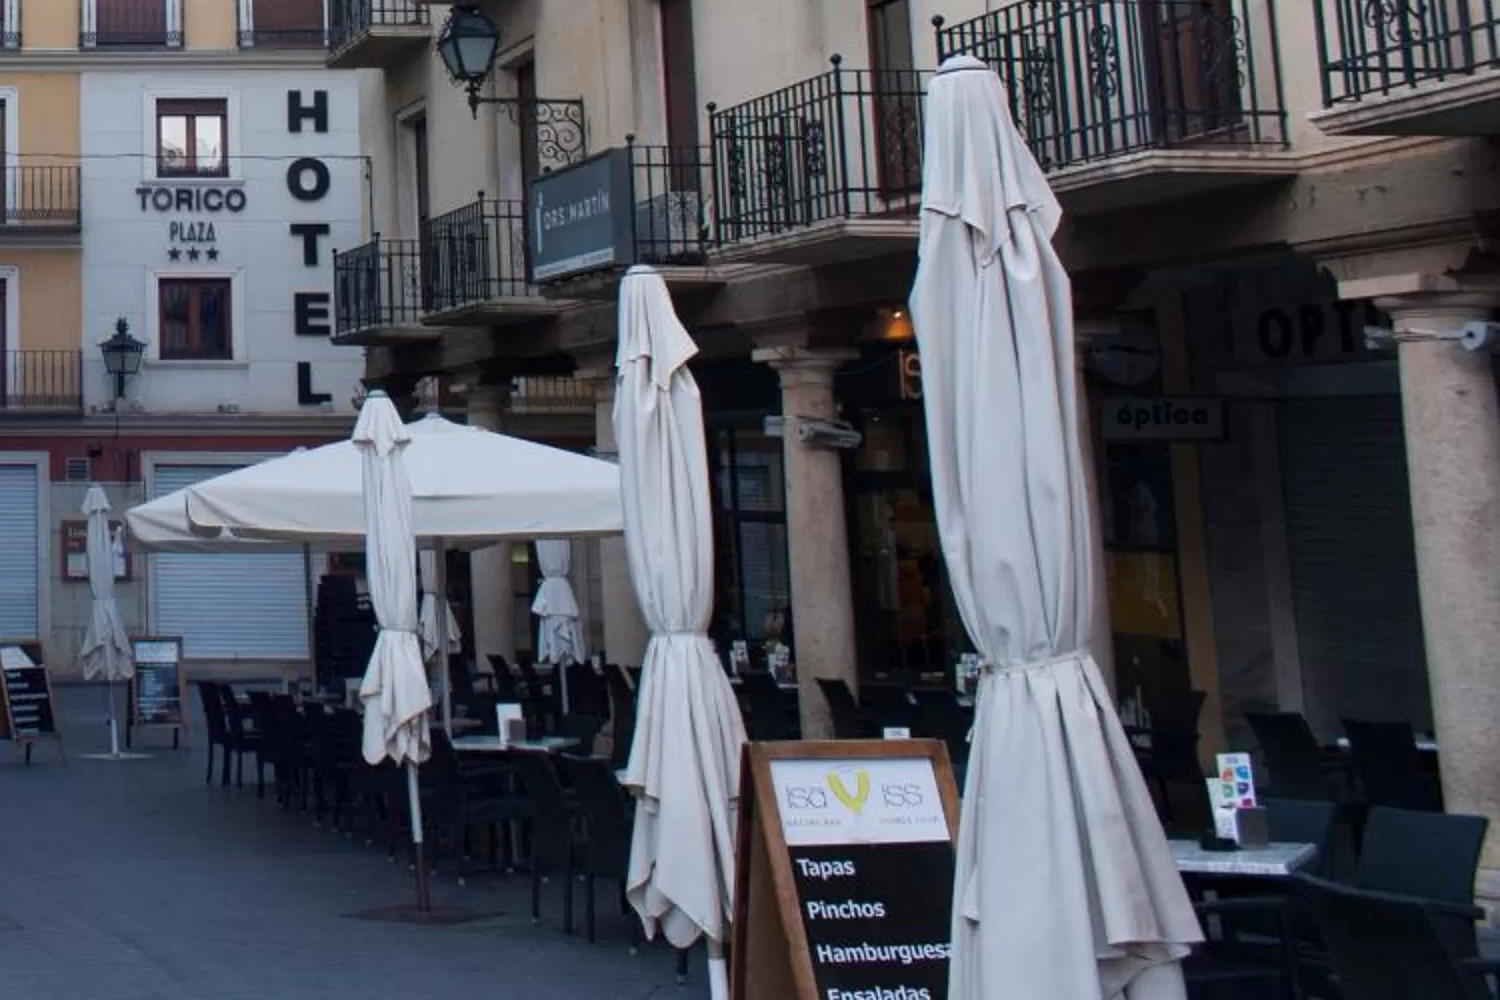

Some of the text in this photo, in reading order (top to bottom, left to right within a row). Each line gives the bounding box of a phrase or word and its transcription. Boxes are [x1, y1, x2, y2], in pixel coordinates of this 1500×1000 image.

[135, 187, 247, 212] TORICO
[169, 220, 217, 242] PLAZA
[286, 89, 333, 406] HOTEL
[796, 858, 856, 881] Tapas
[806, 900, 886, 920] Pinchos
